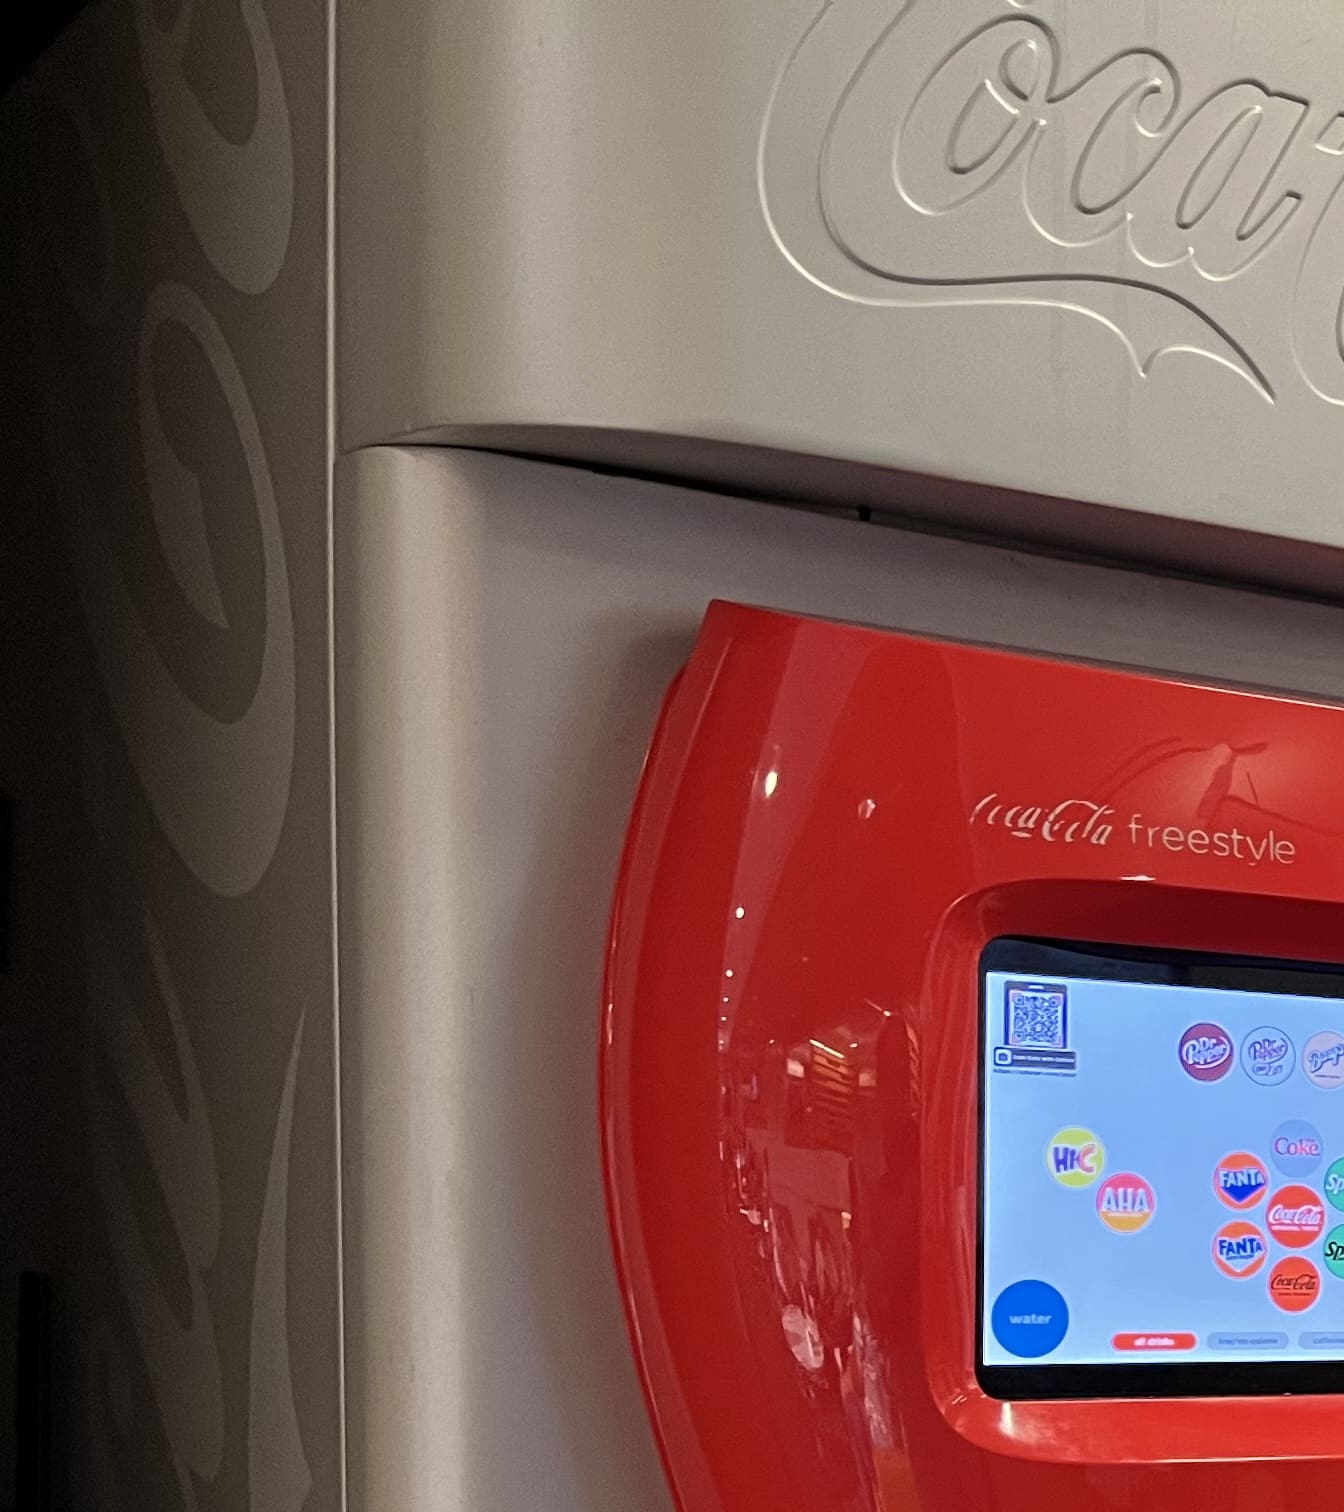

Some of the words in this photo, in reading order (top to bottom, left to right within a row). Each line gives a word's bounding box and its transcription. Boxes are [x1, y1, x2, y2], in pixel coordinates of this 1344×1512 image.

[1127, 813, 1297, 867] freestyle
[1182, 1038, 1229, 1065] Pepper
[1200, 1036, 1217, 1049] Dr
[1248, 1038, 1288, 1061] Pepper
[1264, 1038, 1278, 1049] Dr
[1274, 1136, 1321, 1157] Coke
[1218, 1167, 1265, 1189] FANTA
[1102, 1186, 1150, 1212] AHA
[1218, 1237, 1263, 1257] FANTA
[1009, 1313, 1053, 1326] water
